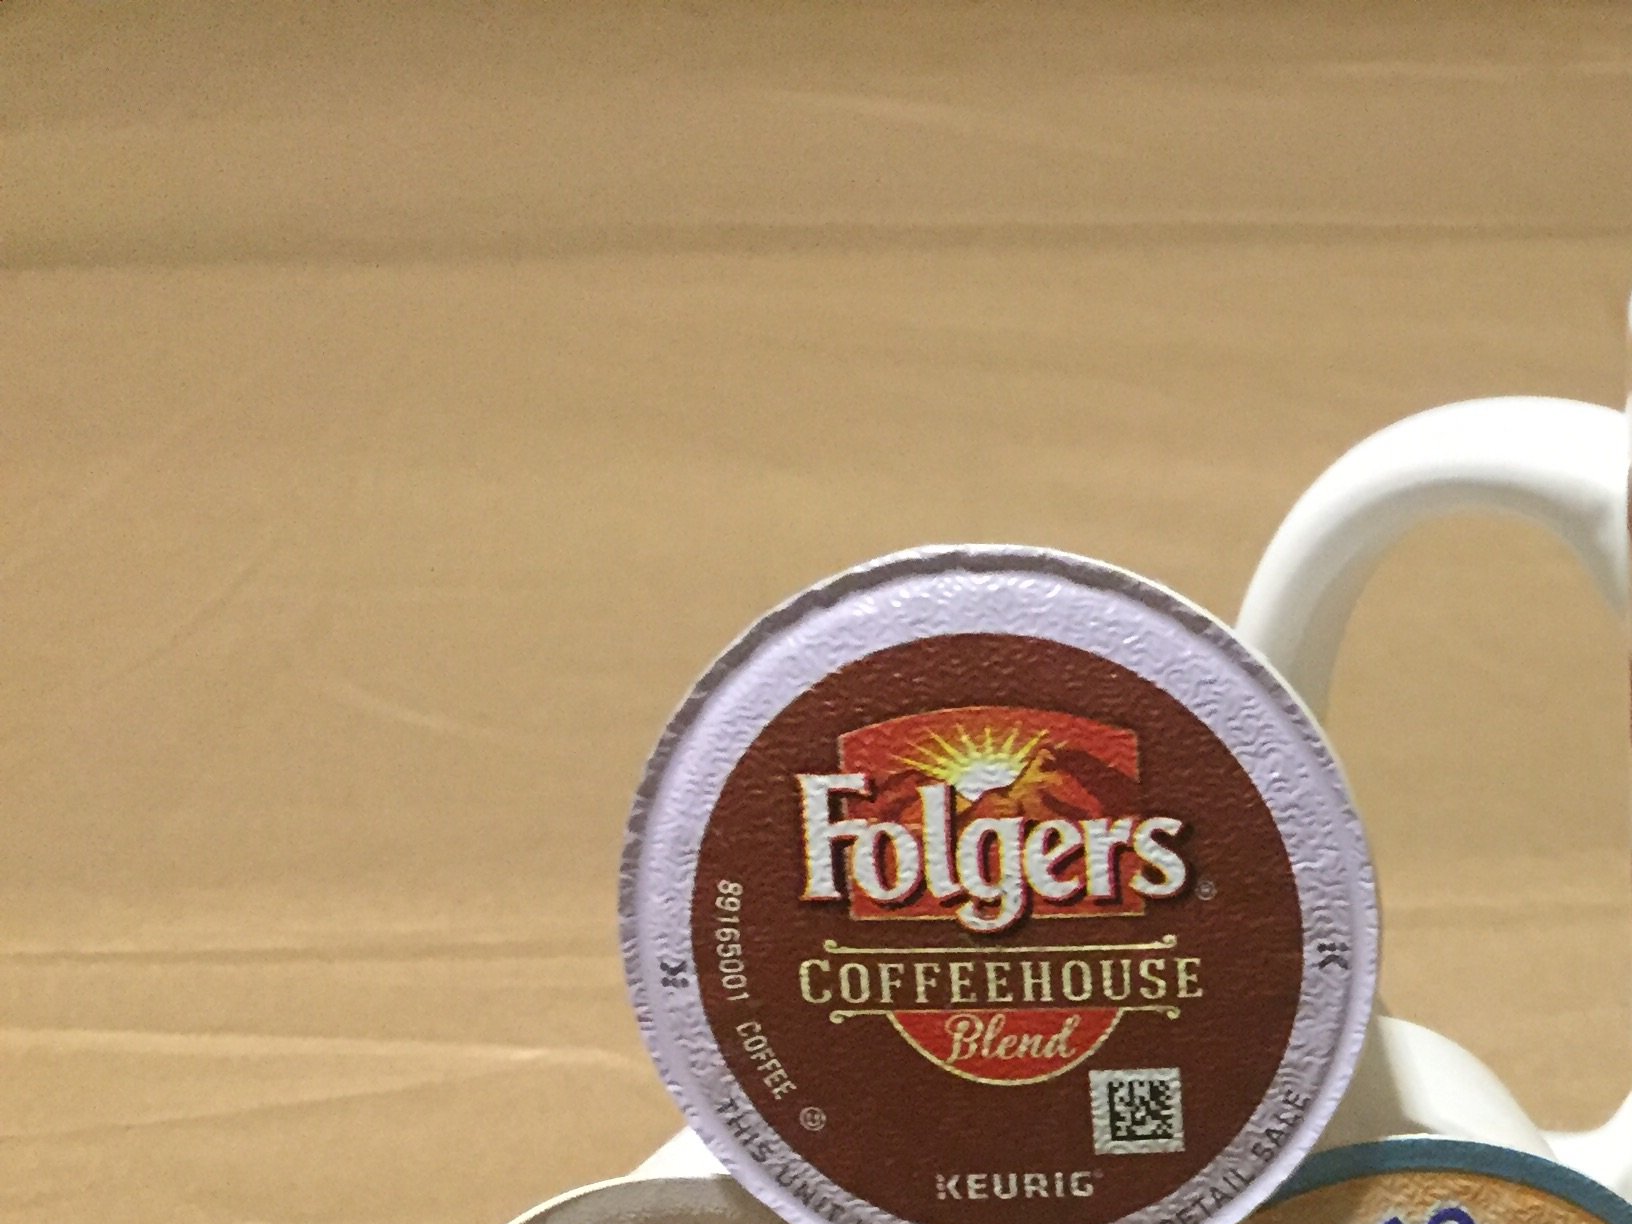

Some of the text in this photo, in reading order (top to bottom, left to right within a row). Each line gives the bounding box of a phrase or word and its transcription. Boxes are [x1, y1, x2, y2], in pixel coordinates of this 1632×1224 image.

[796, 772, 1188, 933] Folgers
[714, 879, 797, 1101] 89165001 COFFEE
[799, 957, 1204, 1004] COFFEEHOUSE
[943, 1012, 1077, 1064] Blend
[716, 1098, 772, 1163] THIS
[1251, 1089, 1312, 1163] SALE
[936, 1171, 1095, 1200] KEURIG
